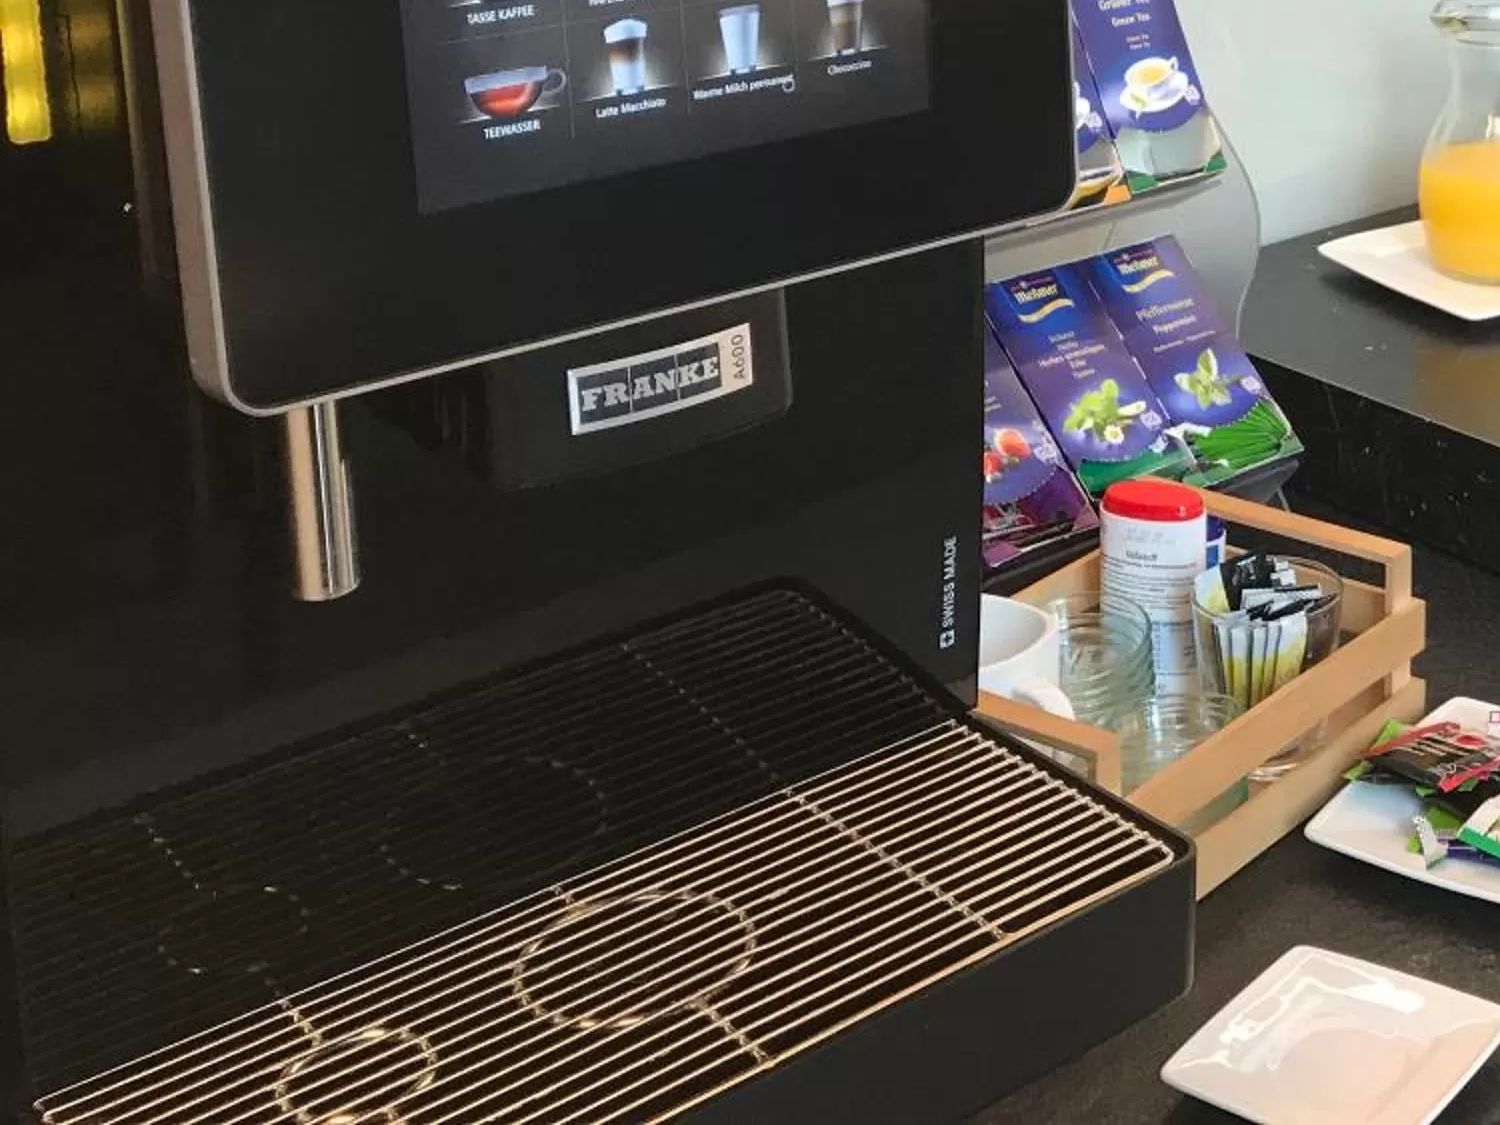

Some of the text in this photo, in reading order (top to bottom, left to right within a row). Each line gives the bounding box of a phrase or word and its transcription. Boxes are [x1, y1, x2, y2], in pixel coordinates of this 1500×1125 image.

[499, 4, 534, 21] KAFFEE
[731, 334, 746, 380] A600
[581, 356, 719, 412] FRANKE
[942, 535, 957, 628] SWISS MADE
